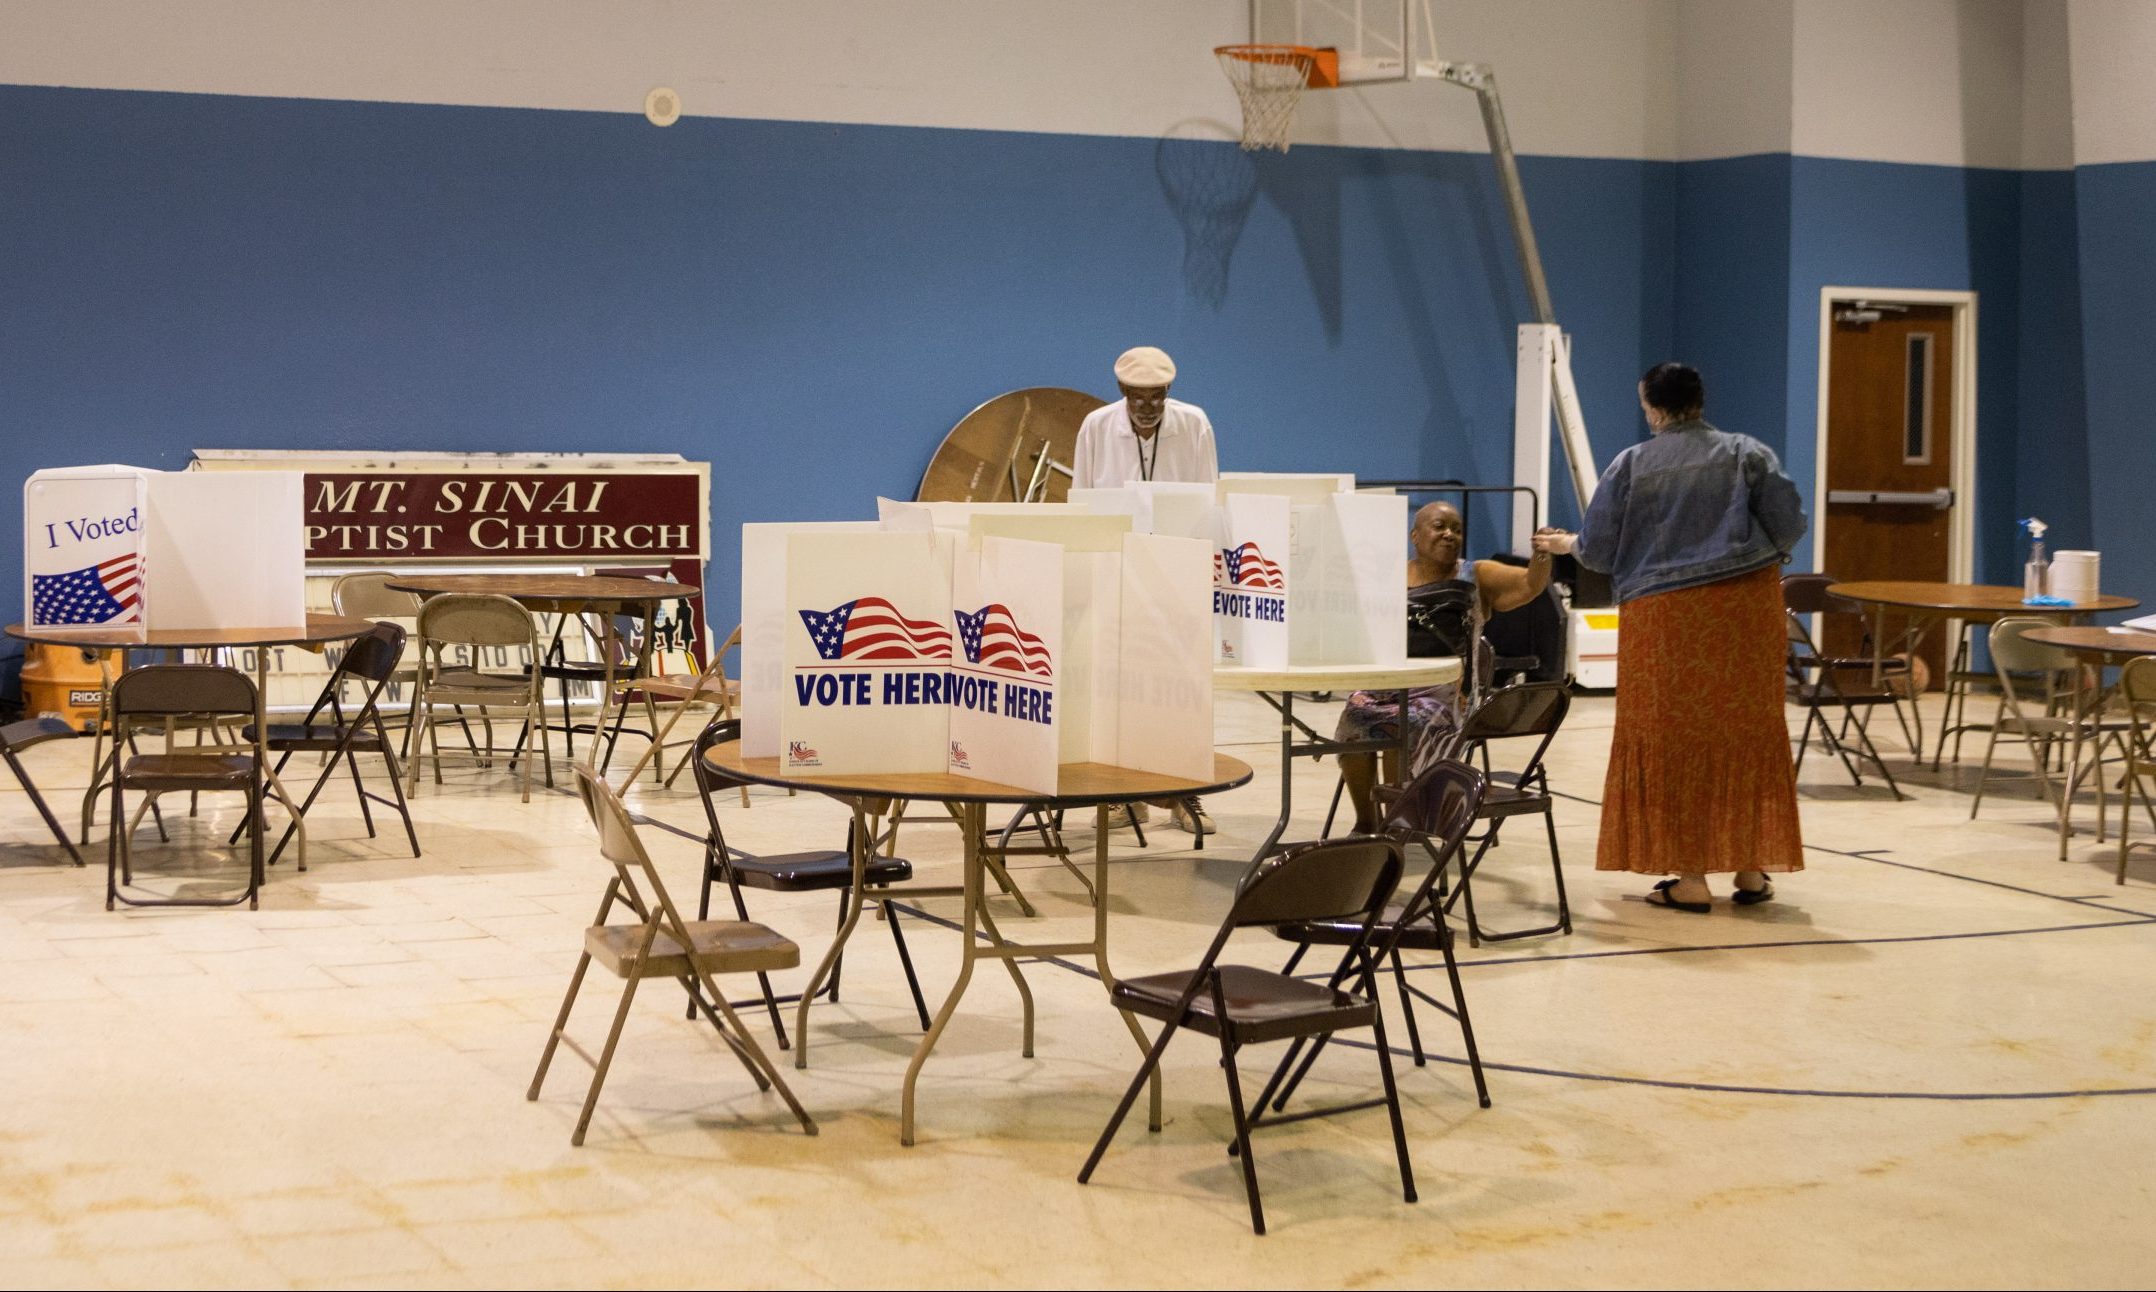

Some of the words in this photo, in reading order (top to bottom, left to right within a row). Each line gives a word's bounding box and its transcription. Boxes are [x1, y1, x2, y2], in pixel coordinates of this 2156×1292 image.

[310, 480, 407, 514] MT.
[434, 480, 610, 514] SINAI
[45, 523, 59, 549] I
[65, 506, 137, 542] Voted
[304, 525, 444, 551] PTIST
[468, 517, 691, 550] CHURCH
[1221, 592, 1251, 618] VOTE
[1255, 596, 1285, 622] HERE
[71, 691, 102, 703] RIDG
[795, 673, 872, 707] VOTE
[951, 673, 998, 714] VOTE
[1004, 683, 1053, 725] HERE
